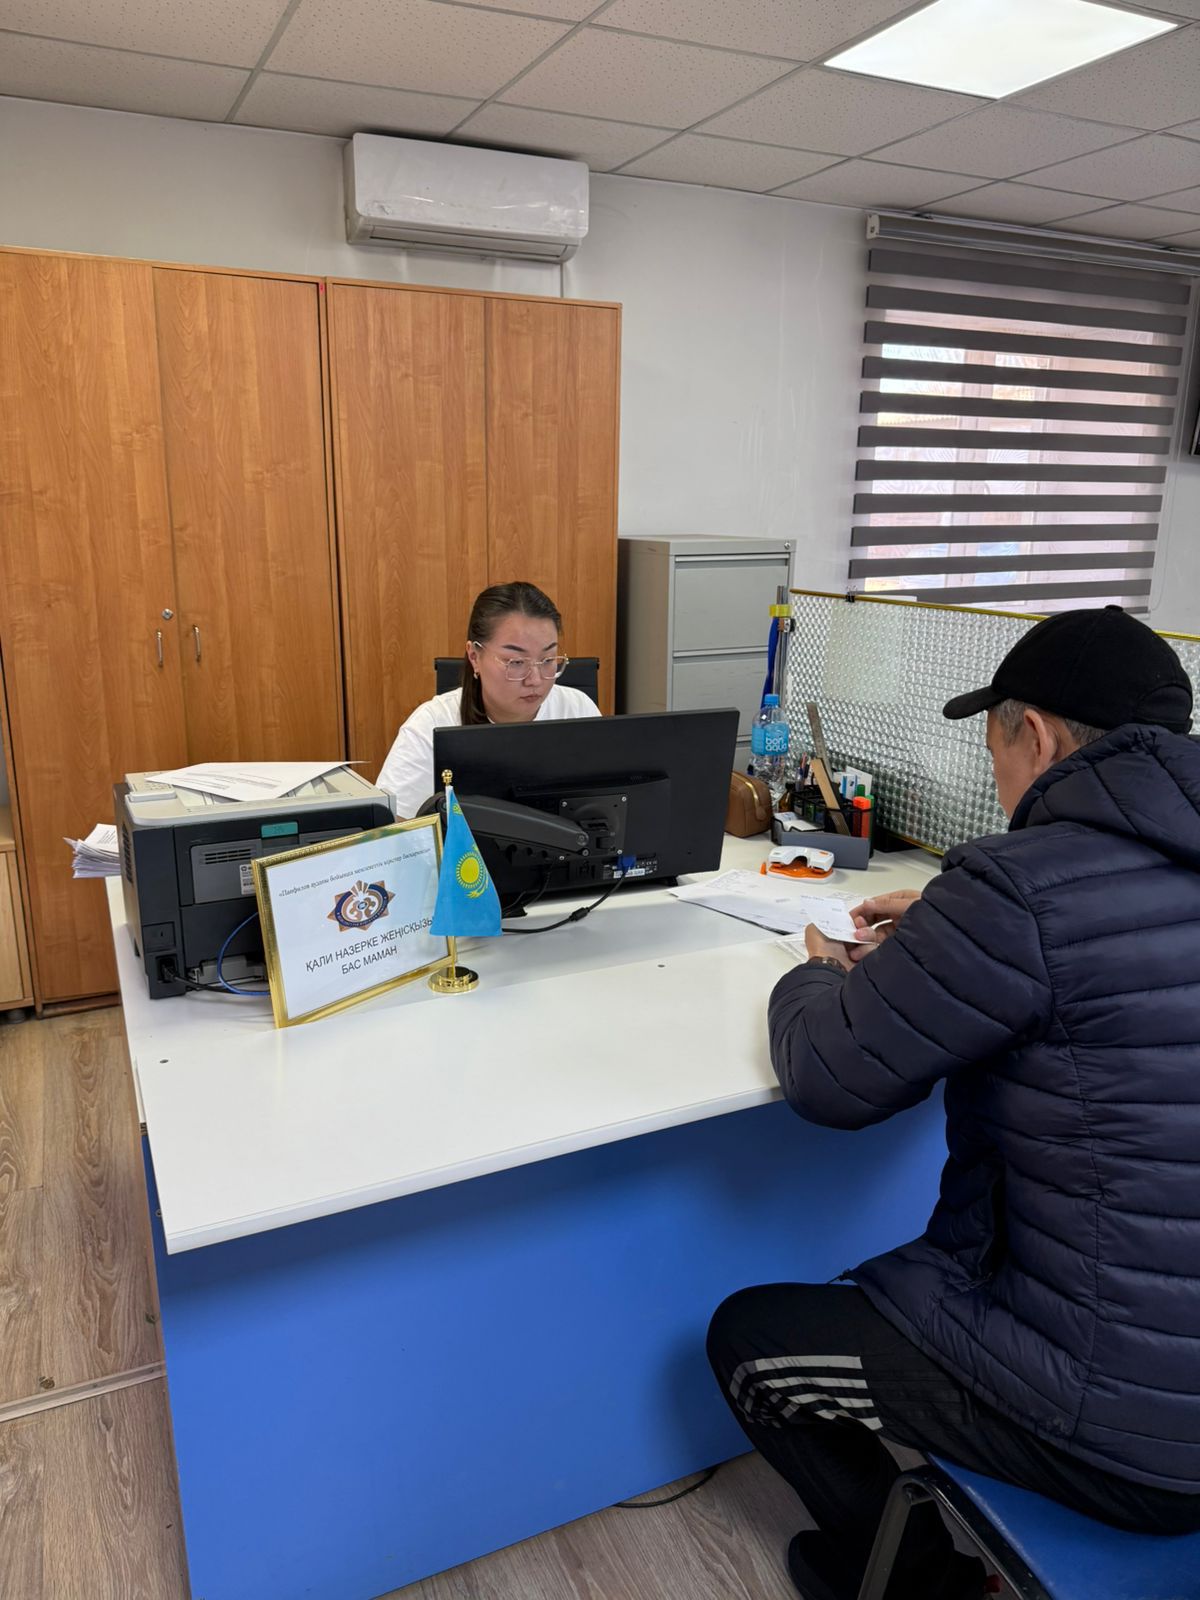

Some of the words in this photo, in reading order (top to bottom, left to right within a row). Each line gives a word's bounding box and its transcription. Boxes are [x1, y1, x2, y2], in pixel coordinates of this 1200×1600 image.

[765, 737, 784, 745] bon
[765, 744, 787, 752] aqua
[305, 953, 334, 973] ҚАЛИ
[335, 937, 379, 961] НАЗЕРКЕ
[342, 959, 362, 975] БАС
[363, 946, 398, 966] МАМАН
